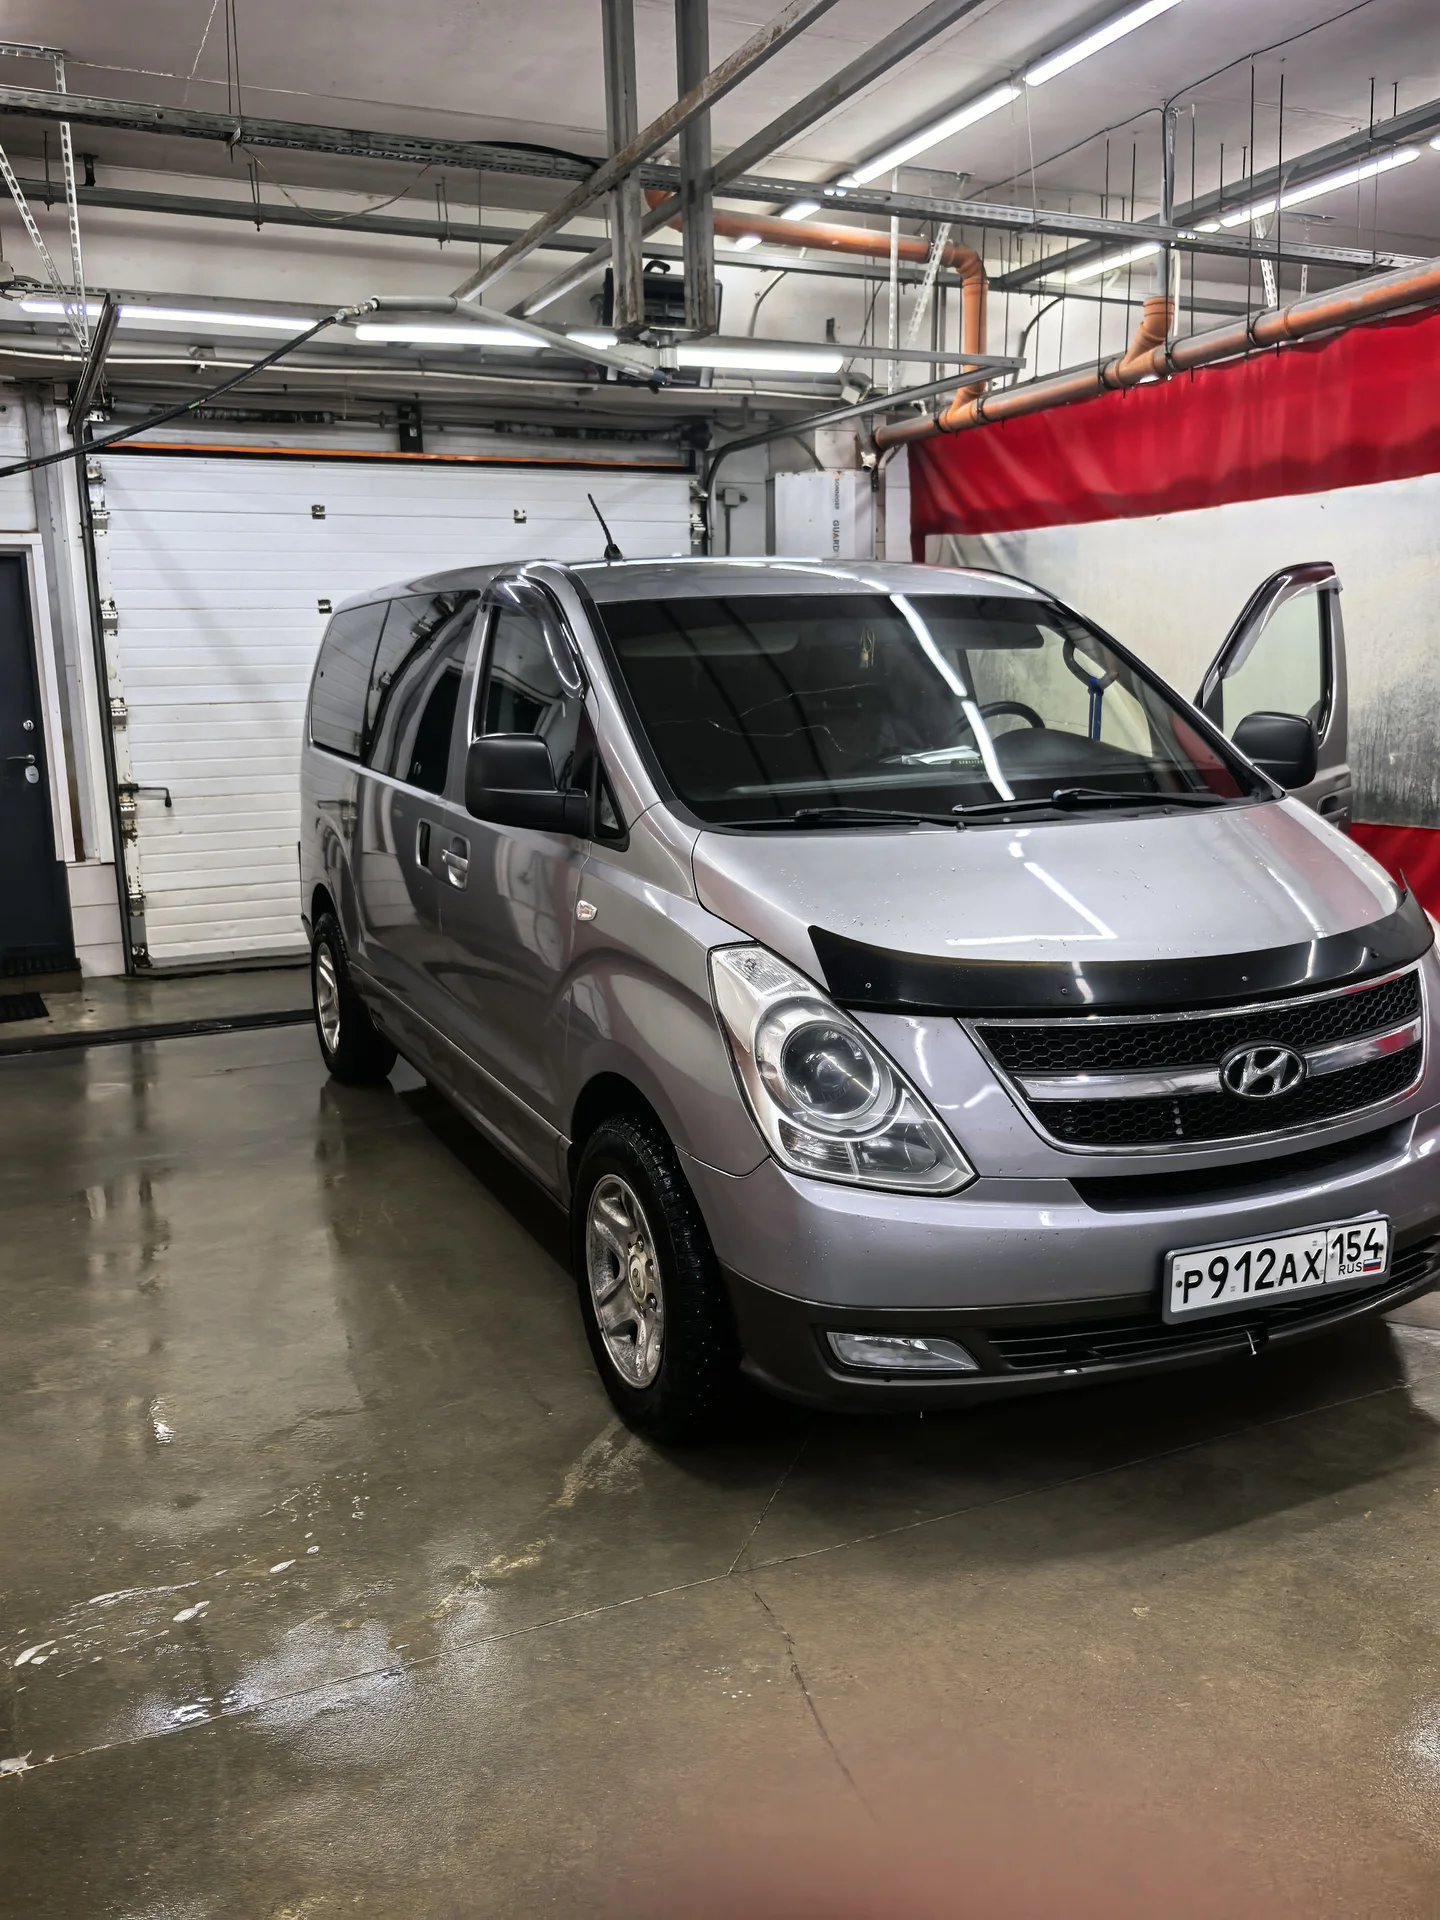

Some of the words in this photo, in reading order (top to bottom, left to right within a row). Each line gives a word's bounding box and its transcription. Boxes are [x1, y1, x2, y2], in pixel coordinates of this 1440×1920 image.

[832, 520, 840, 552] GUARD
[1183, 1248, 1323, 1304] P912AX
[1331, 1228, 1379, 1265] 154
[1338, 1263, 1363, 1276] RUS
